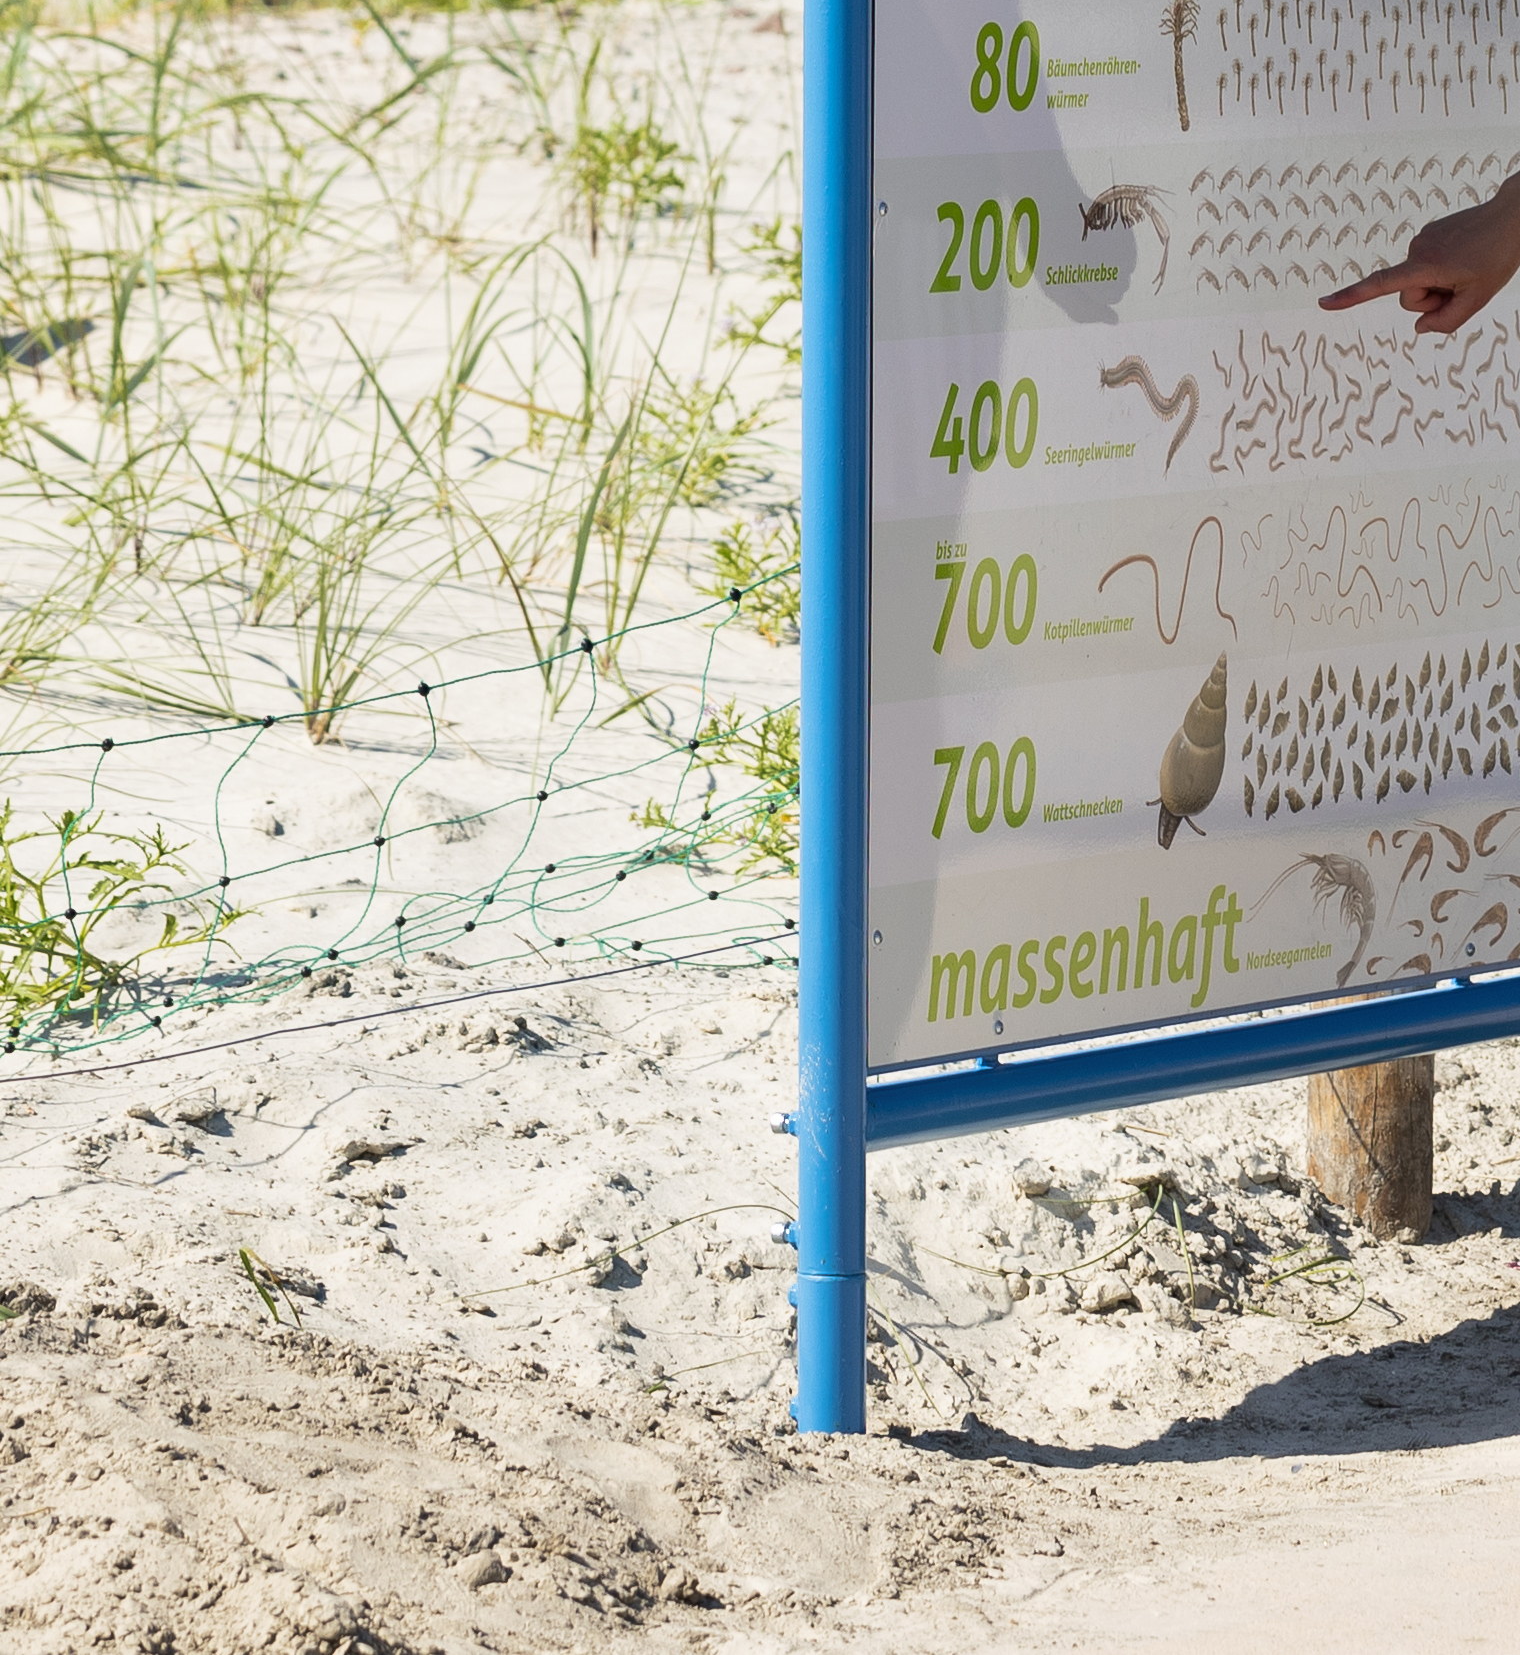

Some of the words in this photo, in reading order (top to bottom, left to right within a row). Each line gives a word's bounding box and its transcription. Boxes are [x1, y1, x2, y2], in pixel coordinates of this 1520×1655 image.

[970, 20, 1040, 113] 80
[1046, 56, 1141, 78] Bäumchenröhren-
[1046, 91, 1089, 109] würmer
[929, 197, 1040, 293] 200
[1045, 265, 1118, 286] Schlickkrebse
[929, 377, 1039, 474] 400
[1044, 441, 1136, 467] Seeringelwürmer
[936, 540, 952, 560] bis
[954, 543, 968, 559] zu
[932, 553, 1038, 655] 700
[1043, 615, 1135, 644] Kotpillenwürmer
[931, 736, 1037, 840] 700
[1043, 796, 1123, 824] Wattschnecken
[927, 884, 1243, 1022] massenhaft
[1246, 941, 1332, 971] Nordseegarnelen
